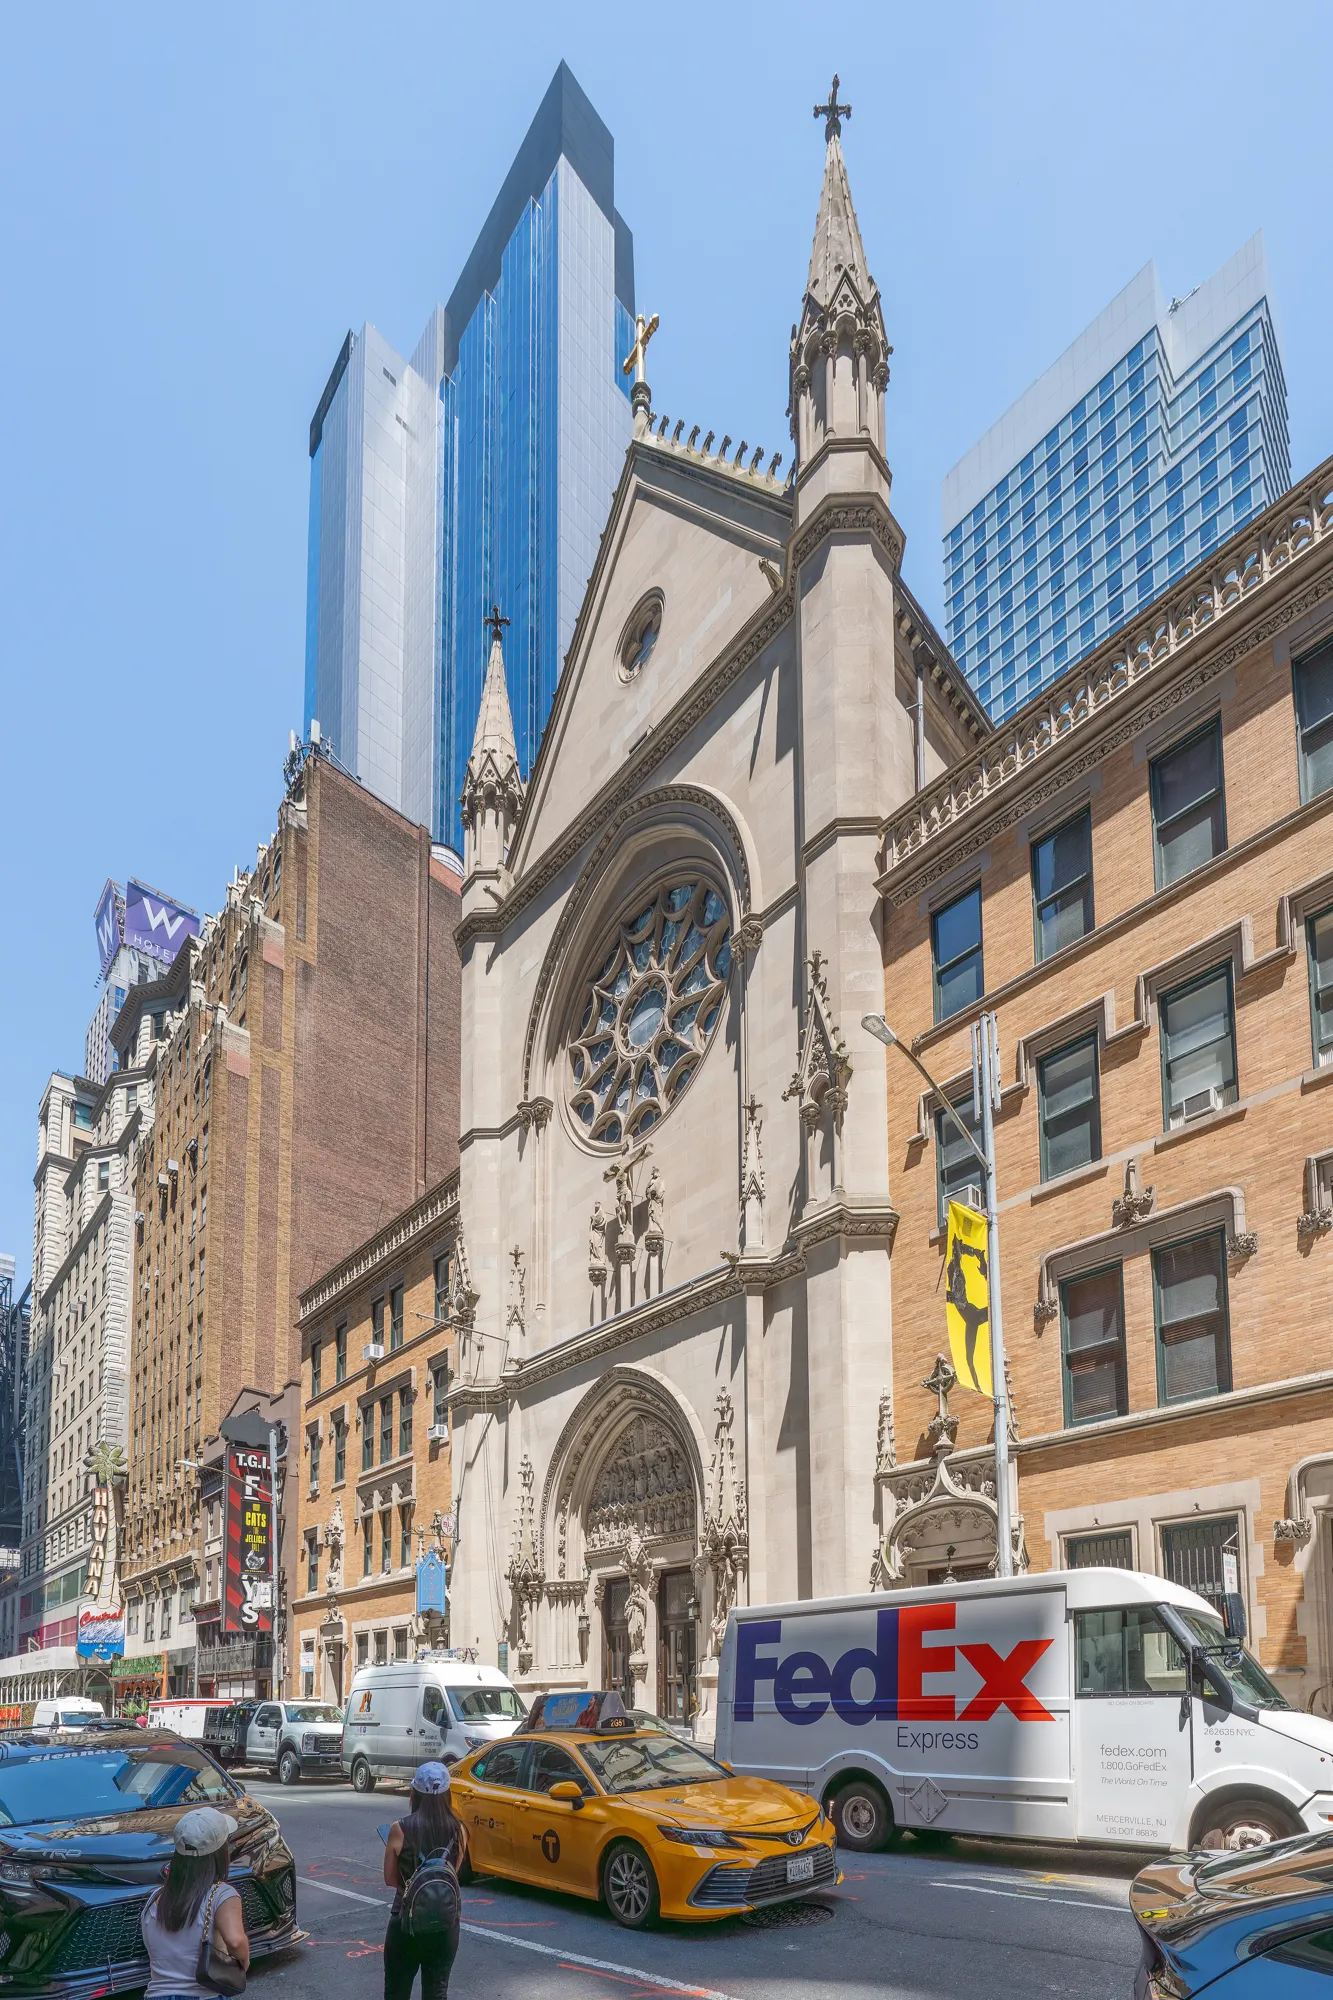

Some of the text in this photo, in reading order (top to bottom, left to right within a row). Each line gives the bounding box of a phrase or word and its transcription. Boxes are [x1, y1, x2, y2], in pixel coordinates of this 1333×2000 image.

[142, 896, 185, 940] W
[236, 1453, 271, 1469] T.G.I.
[245, 1511, 267, 1528] CATS
[84, 1487, 108, 1595] HAVANA
[80, 1607, 123, 1628] Central
[734, 1602, 1056, 1726] FedEx
[610, 1719, 625, 1728] 2G51
[897, 1726, 978, 1753] Express
[1203, 1728, 1255, 1737] 262635 NYC
[1101, 1744, 1167, 1757] fedex.com
[1101, 1761, 1167, 1771] 1.800.GoFedEx
[1096, 1814, 1167, 1826] MERCERVILLE, NJ
[1106, 1826, 1116, 1834] US
